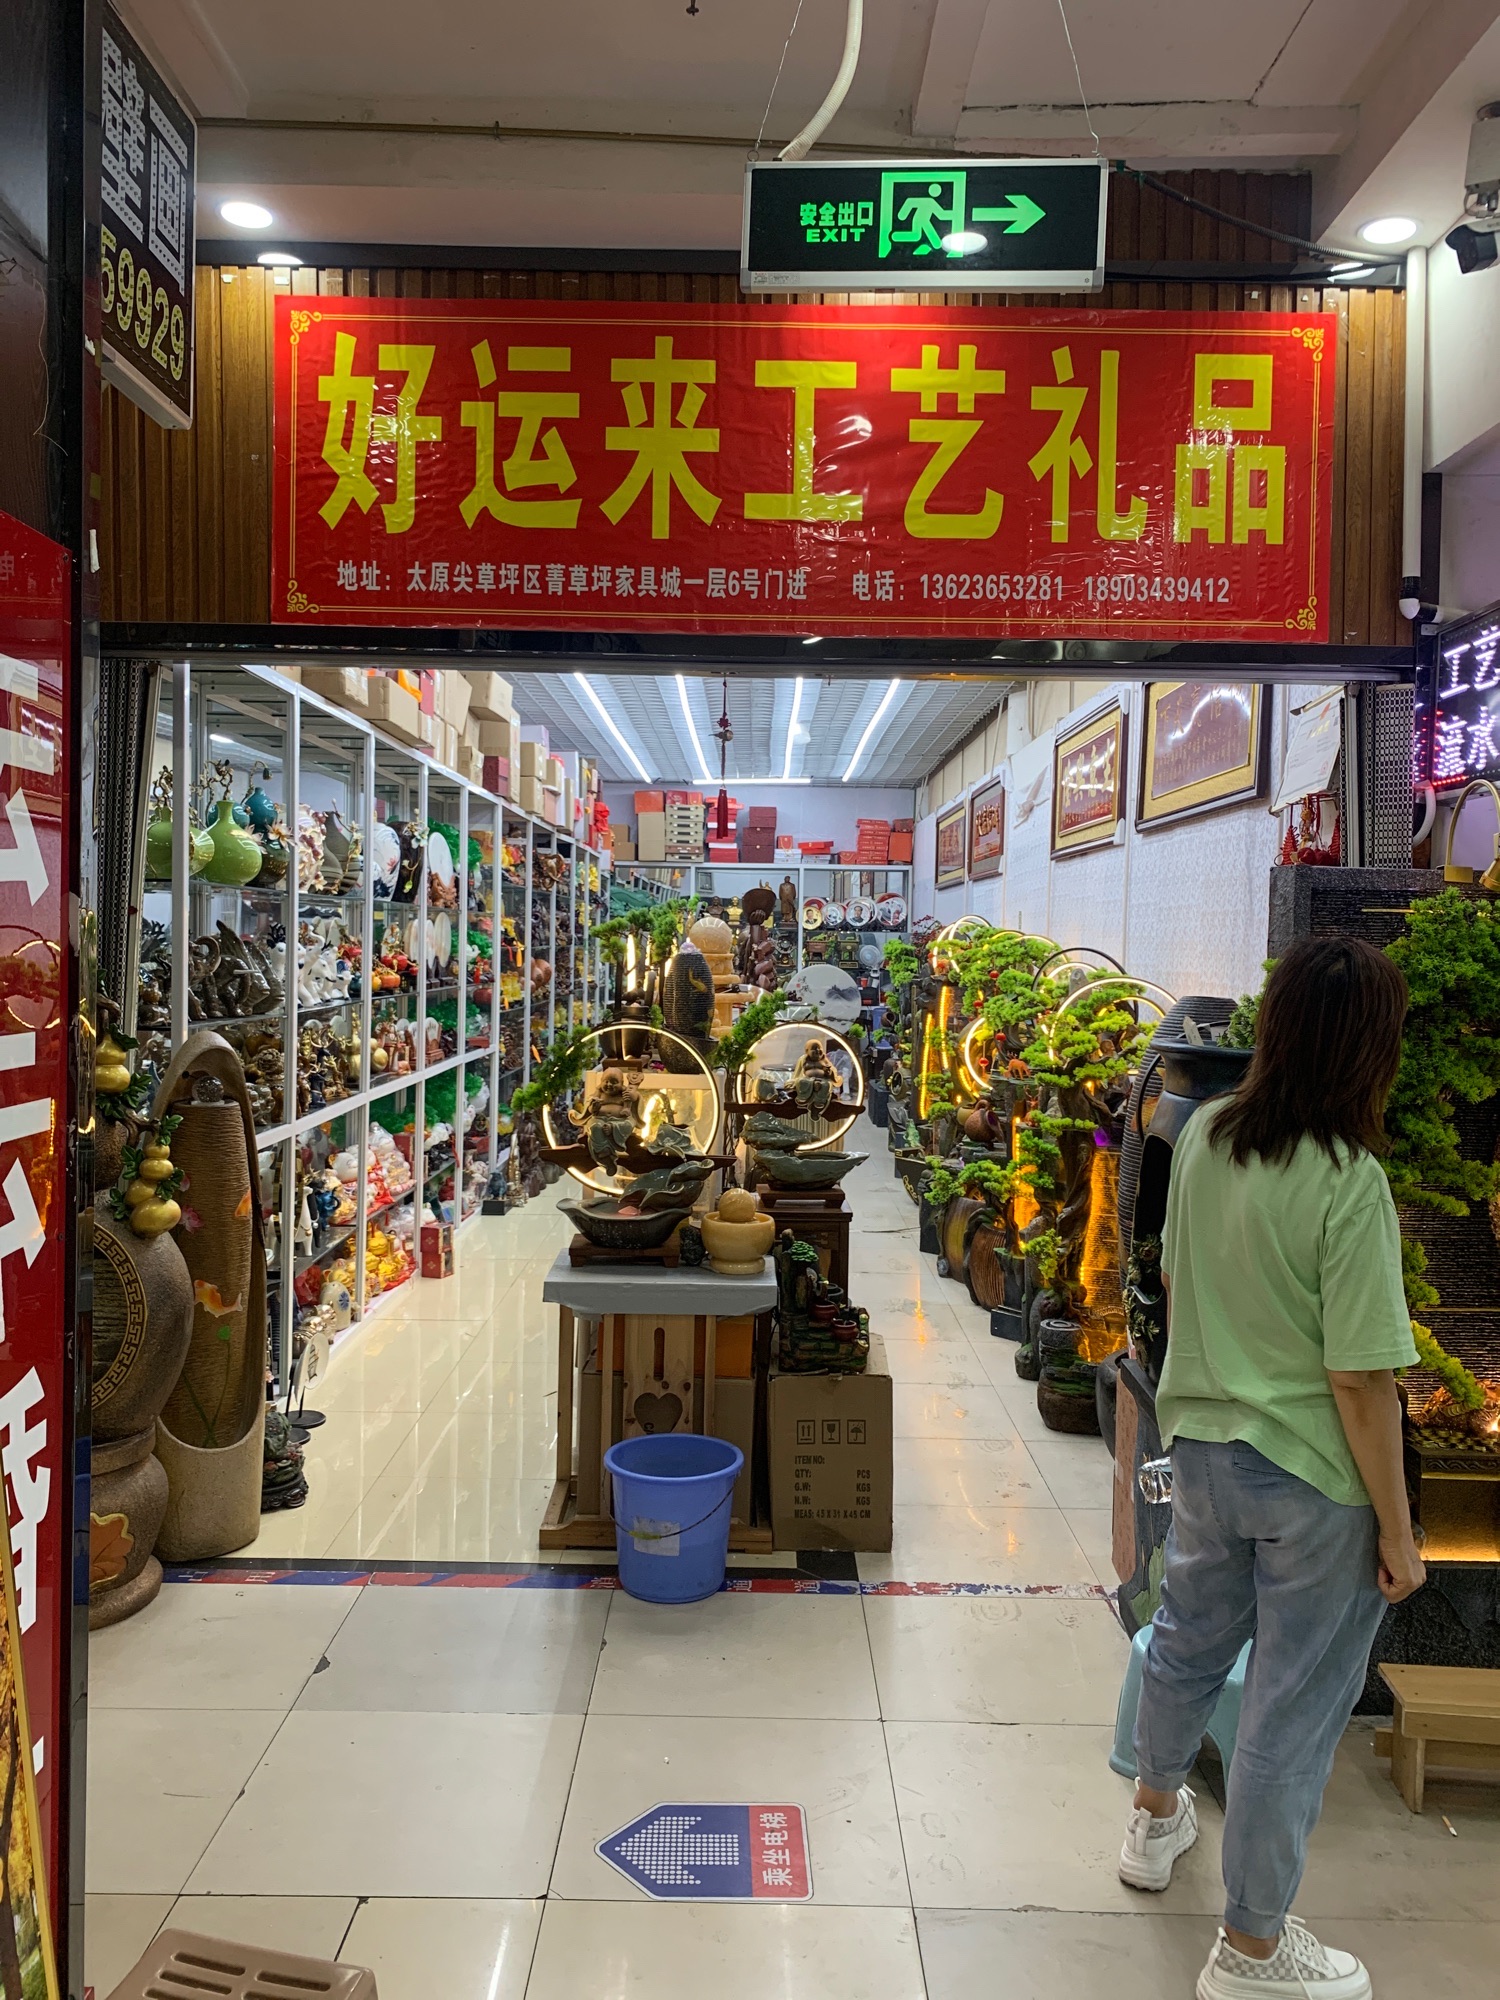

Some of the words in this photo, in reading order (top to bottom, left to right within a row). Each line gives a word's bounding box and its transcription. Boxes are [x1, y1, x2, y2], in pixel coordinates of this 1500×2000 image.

[800, 202, 873, 226] 安全出口
[806, 228, 865, 242] EXIT
[318, 331, 1286, 544] 好运来工艺礼品
[920, 573, 1064, 601] 13623653281
[1085, 576, 1230, 603] 18903439412
[794, 1455, 812, 1464] ITEM
[812, 1455, 825, 1464] NO:
[794, 1469, 812, 1478] QTY:
[856, 1470, 871, 1479] PCS
[794, 1482, 811, 1491] G.W:
[856, 1483, 871, 1492] KGS
[794, 1496, 811, 1505] N.W:
[856, 1497, 871, 1506] KGS
[794, 1510, 814, 1519] MEAS:
[826, 1510, 831, 1519] X
[843, 1510, 848, 1519] X
[860, 1510, 871, 1519] CM
[760, 1812, 793, 1886] 乘坐电梯
